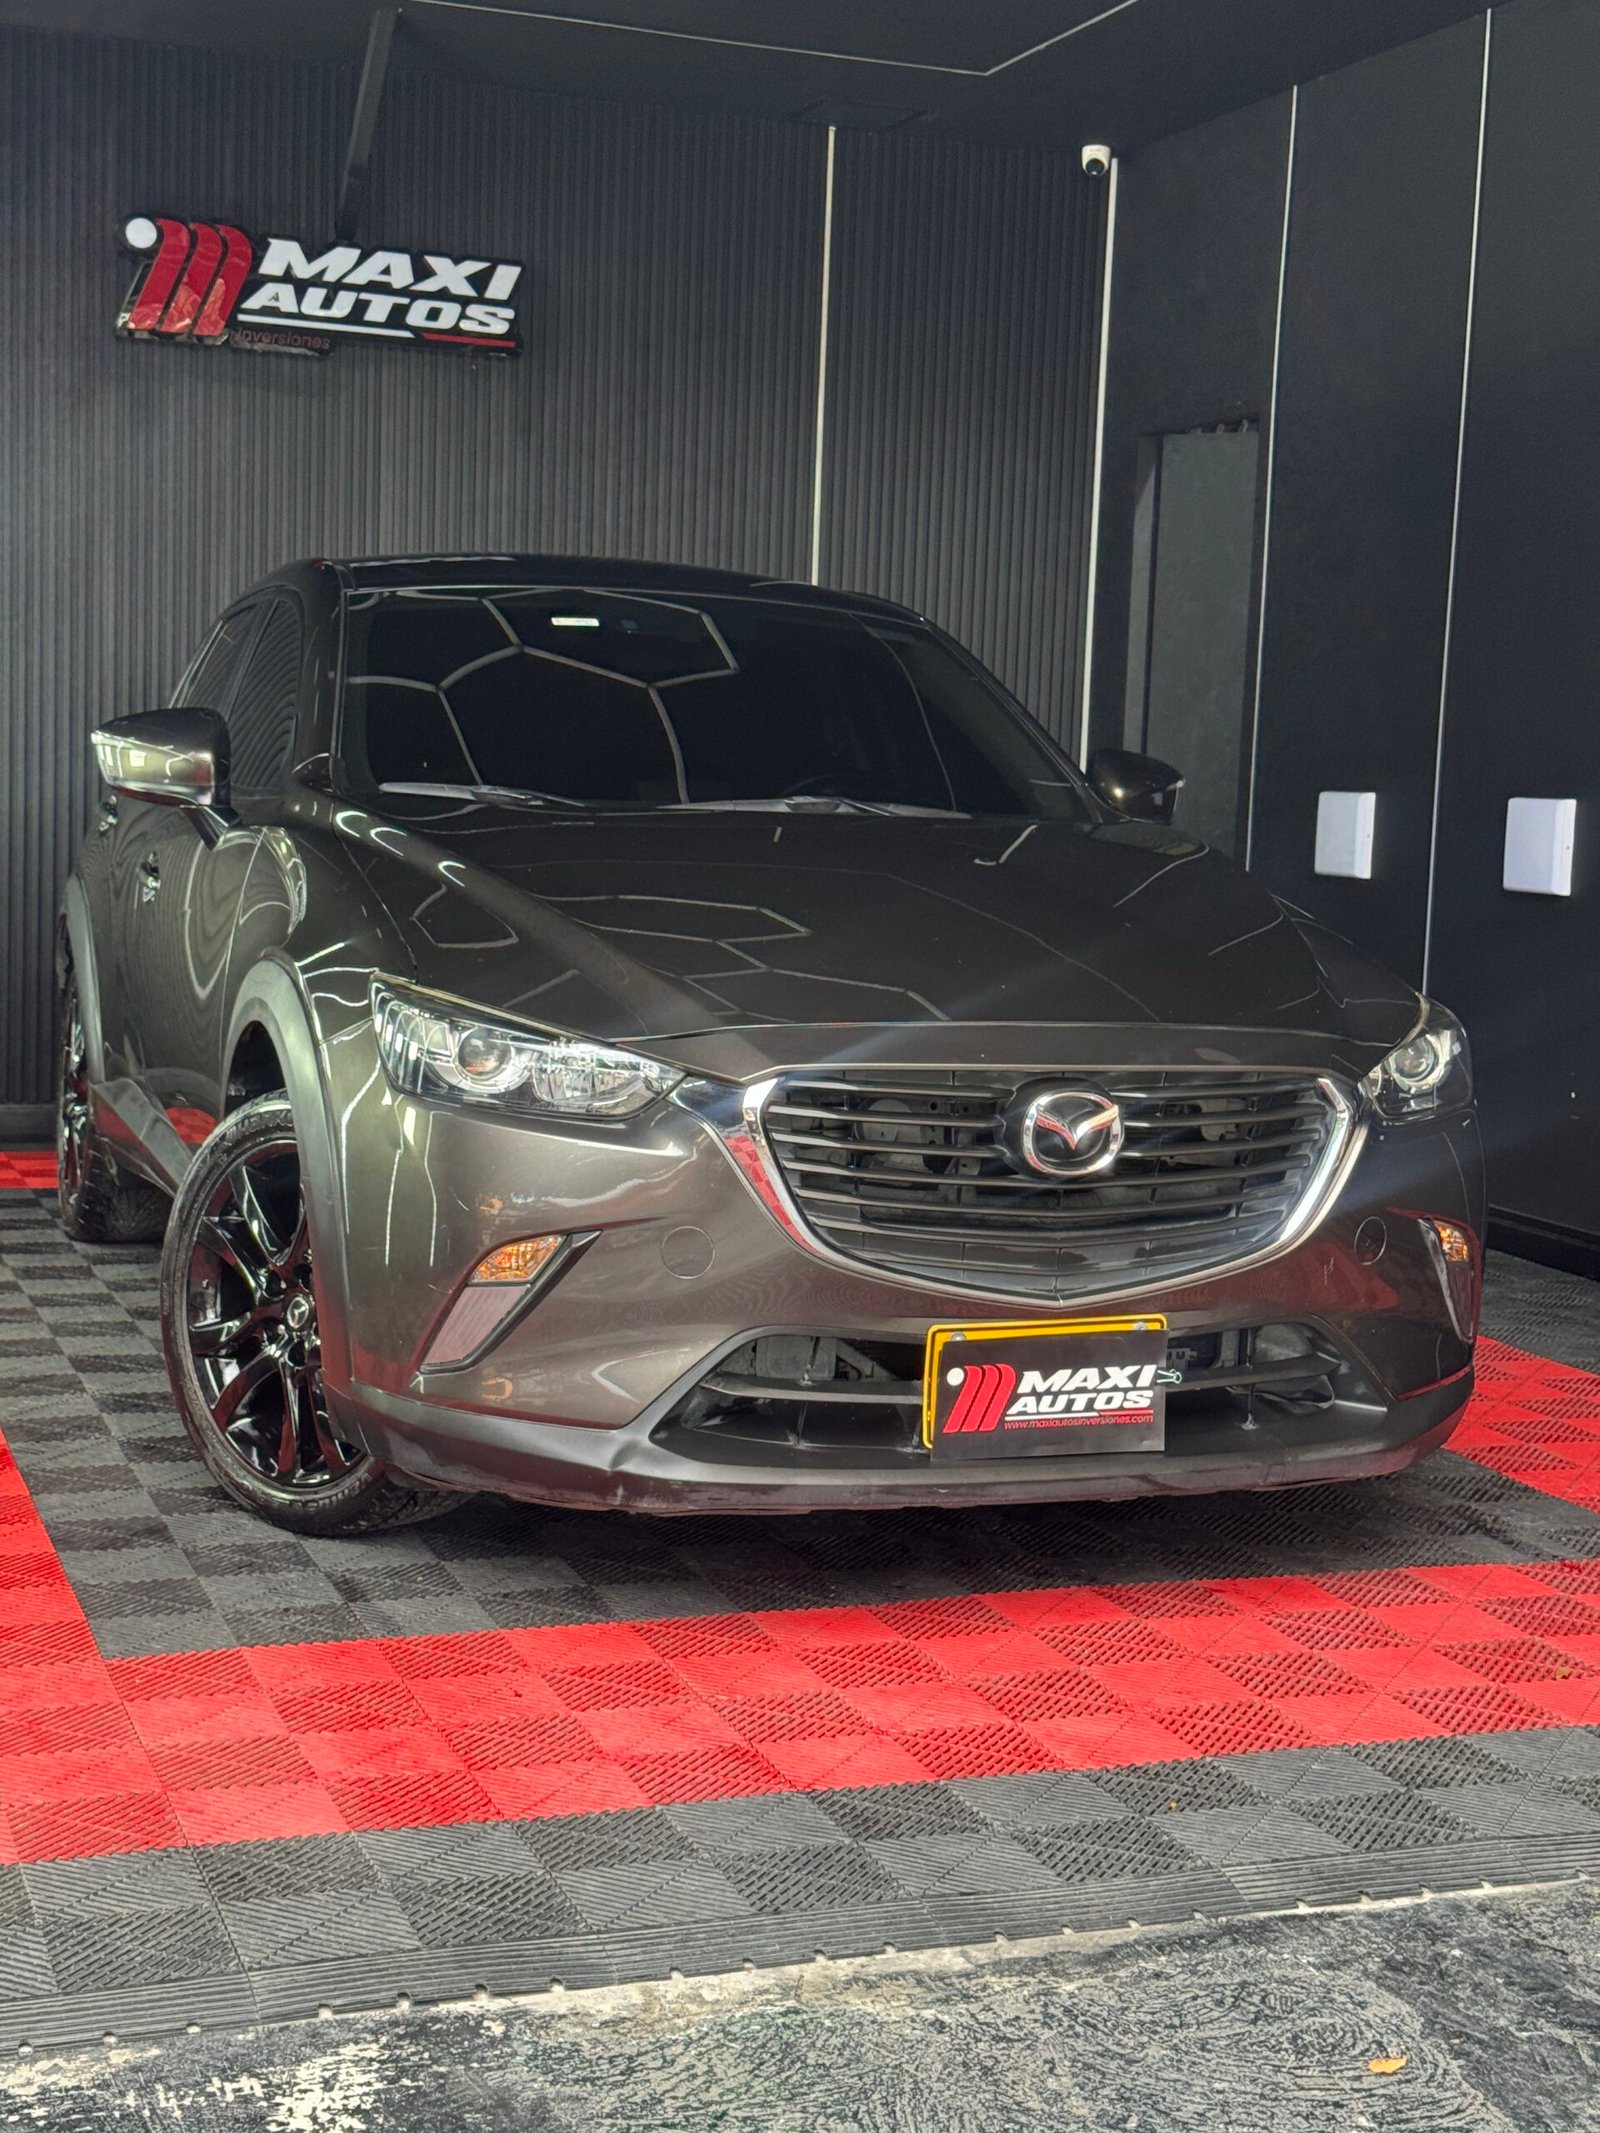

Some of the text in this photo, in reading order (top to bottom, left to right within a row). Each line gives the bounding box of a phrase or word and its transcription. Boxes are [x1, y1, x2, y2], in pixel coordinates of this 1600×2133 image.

[258, 238, 521, 301] MAXI
[241, 282, 515, 335] AUTOS
[1017, 1364, 1157, 1393] MAXI
[1006, 1390, 1153, 1415] AUTOS
[1004, 1414, 1154, 1430] www.maxiautosinversiones.com
